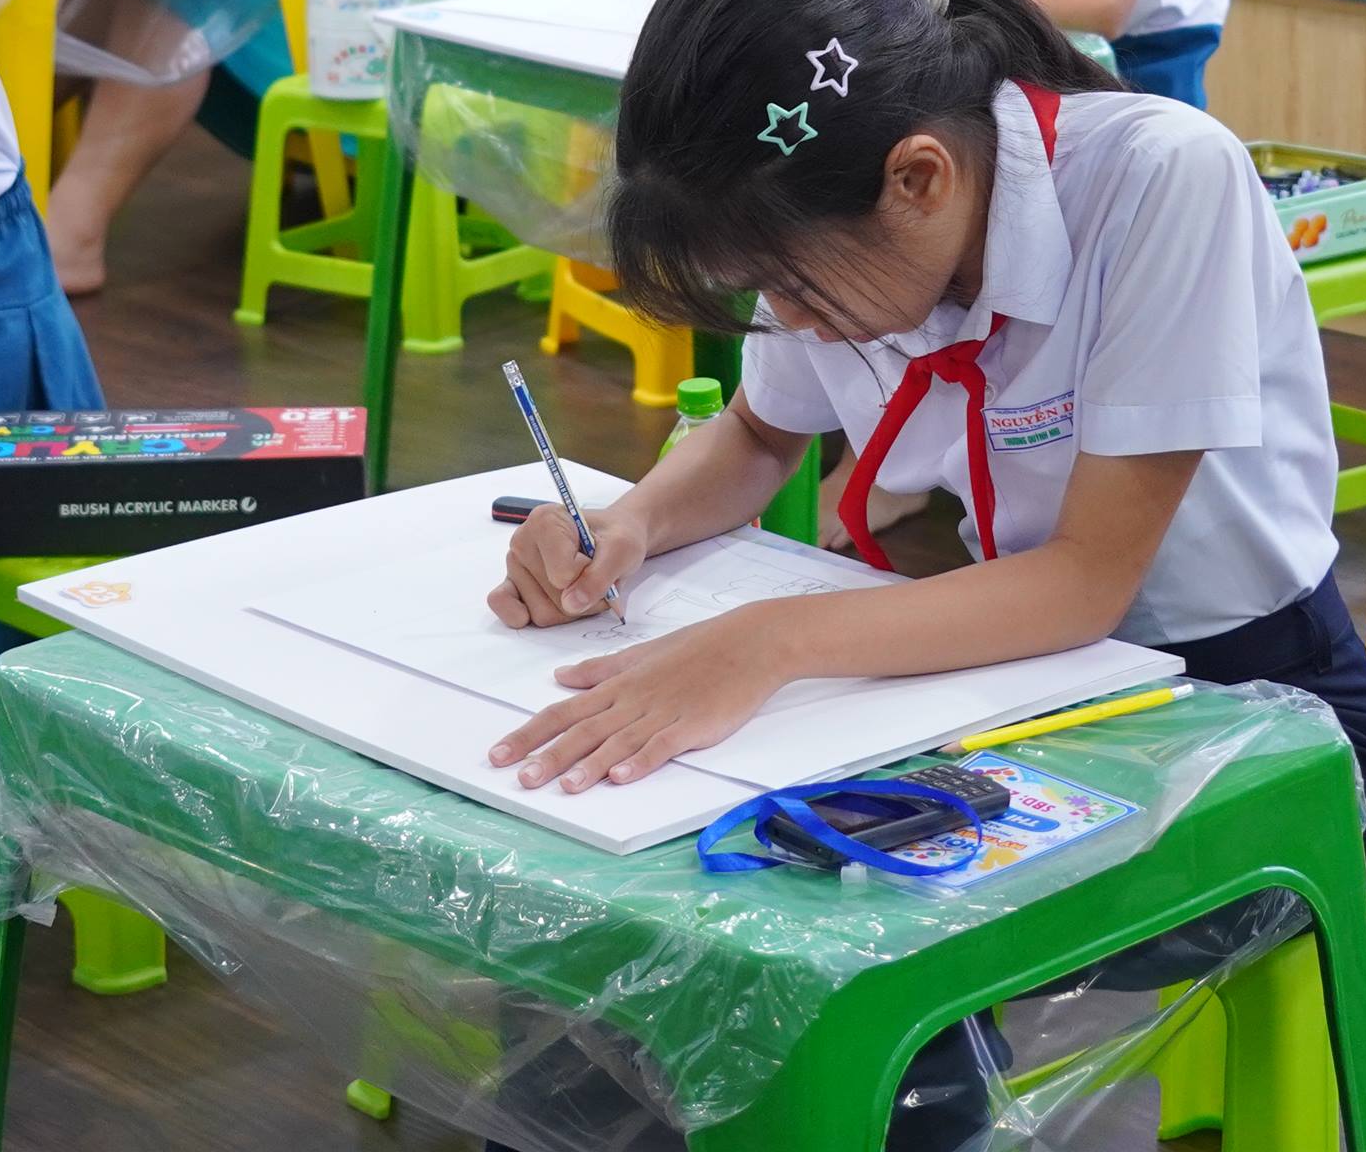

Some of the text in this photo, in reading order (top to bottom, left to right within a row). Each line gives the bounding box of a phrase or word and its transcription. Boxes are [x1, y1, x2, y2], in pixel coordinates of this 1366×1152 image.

[1062, 401, 1074, 412] D
[73, 434, 164, 442] MARKER
[167, 432, 227, 440] BRUSH
[59, 499, 238, 517] BRUSH ACRYLIC MARKER
[1019, 794, 1057, 813] SBD:
